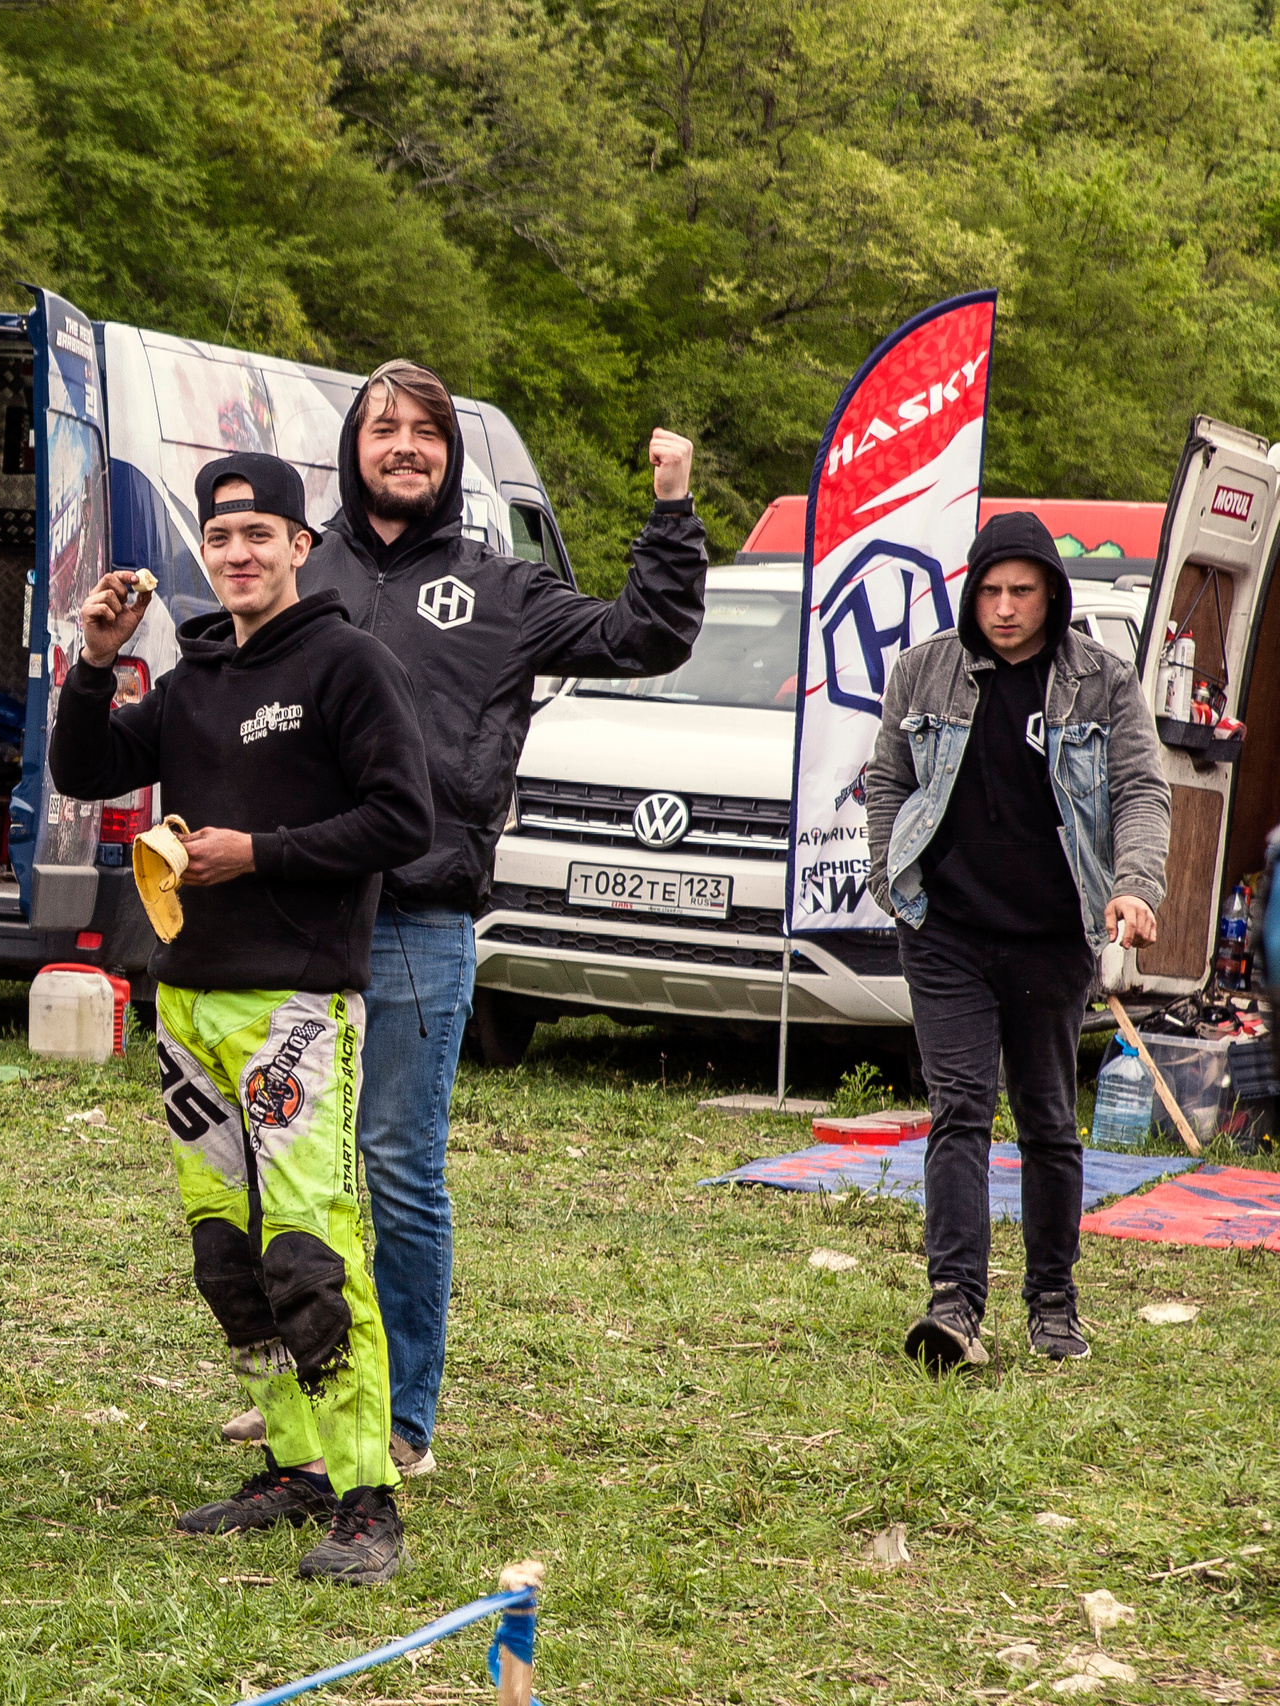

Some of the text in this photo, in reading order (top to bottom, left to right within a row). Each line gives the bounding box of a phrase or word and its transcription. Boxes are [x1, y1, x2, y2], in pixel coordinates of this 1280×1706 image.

[828, 350, 988, 477] HASKY
[1213, 487, 1251, 517] MOTUL
[240, 704, 303, 737] START MOTO
[242, 719, 301, 745] RACING TEAM
[684, 877, 722, 899] 123
[690, 897, 710, 907] RUS
[342, 1083, 354, 1137] MOTO
[342, 1137, 355, 1197] START
